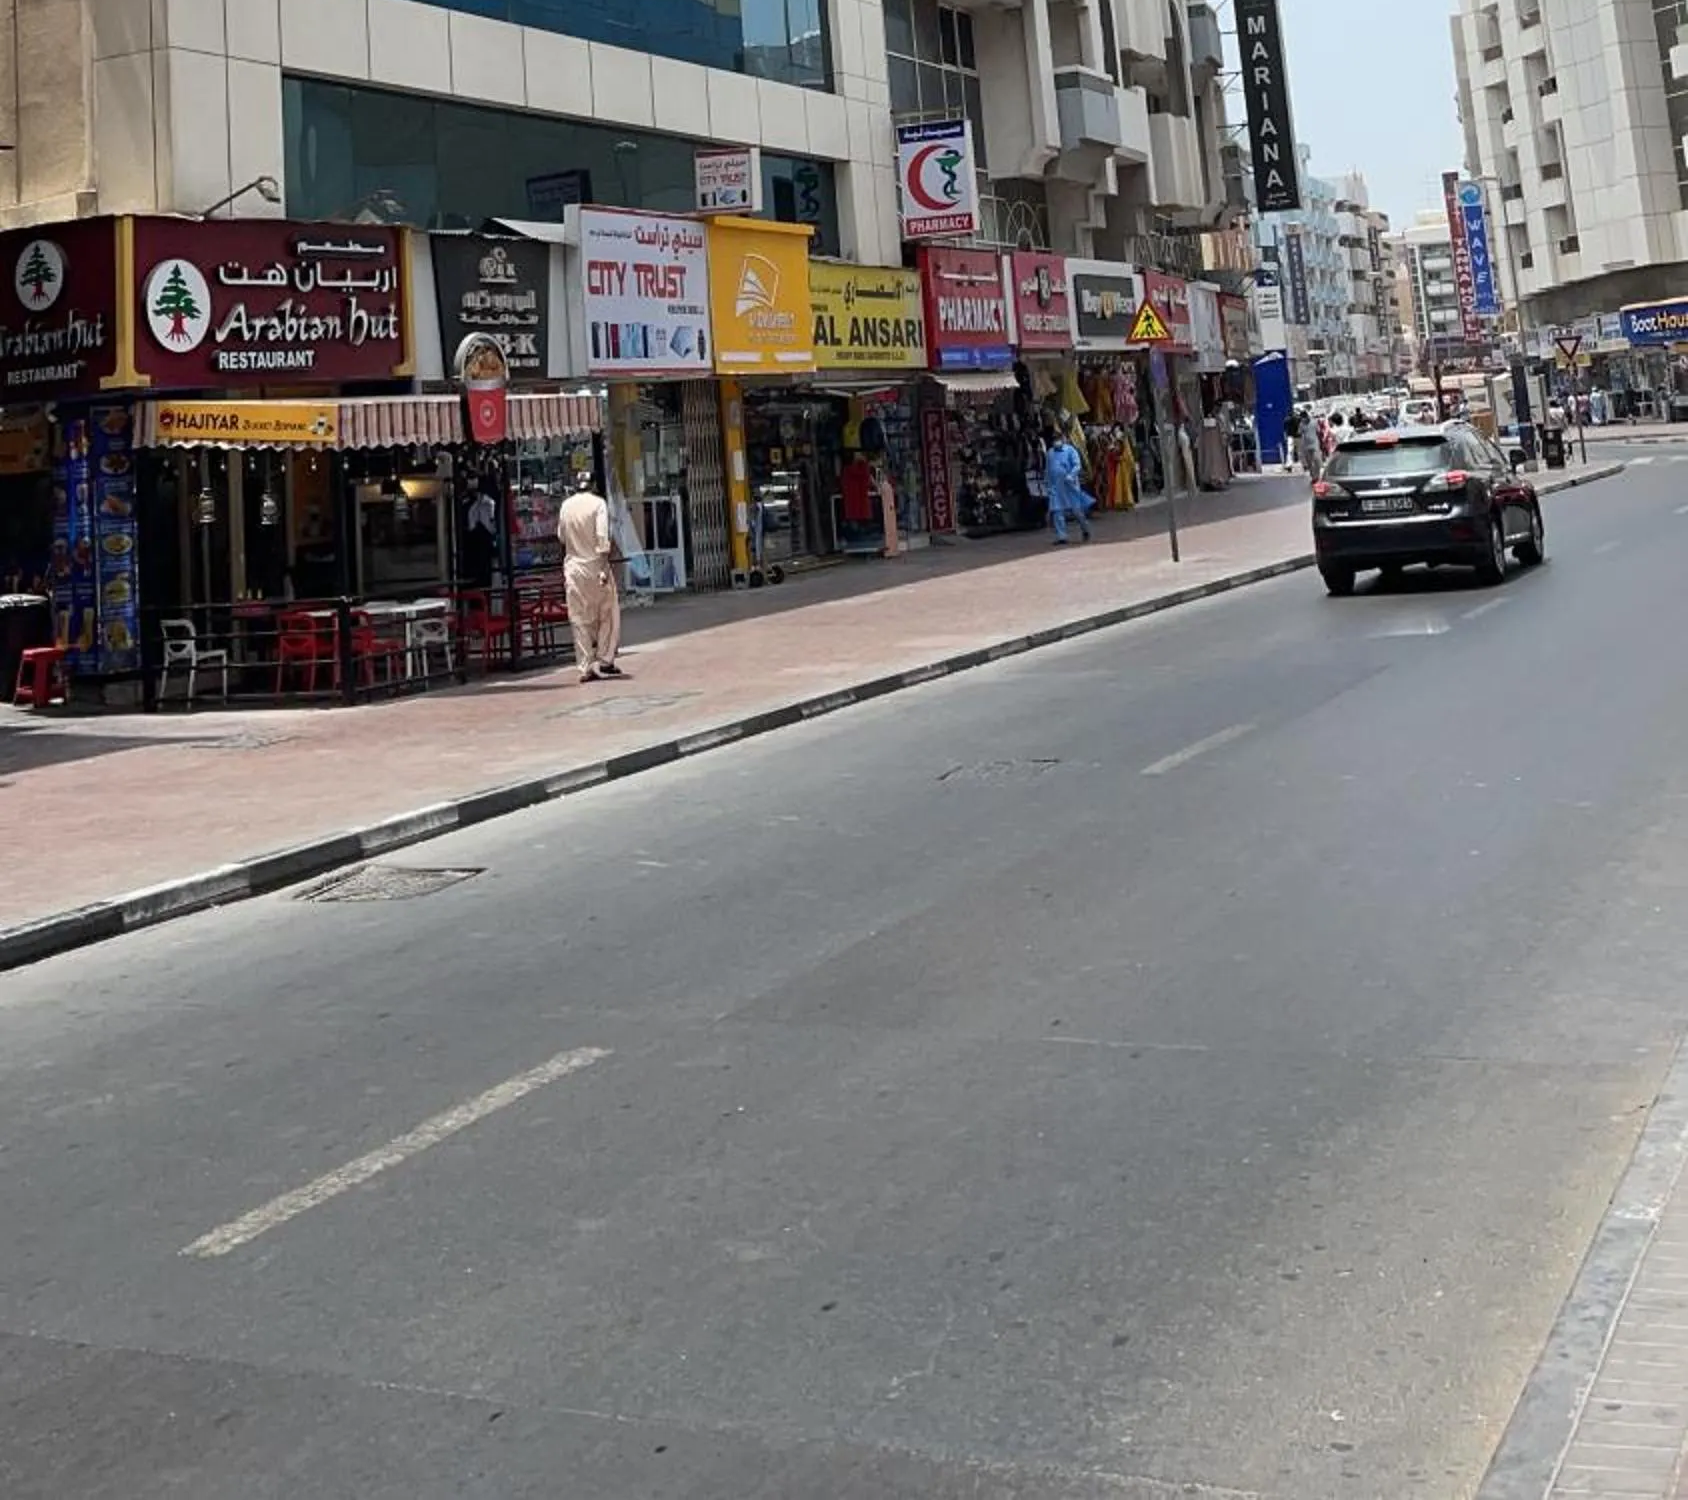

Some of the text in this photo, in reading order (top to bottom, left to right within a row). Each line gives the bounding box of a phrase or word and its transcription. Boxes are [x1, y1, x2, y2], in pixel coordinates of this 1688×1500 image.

[1246, 14, 1285, 189] MARIANA
[909, 214, 971, 234] PHARMACY
[297, 240, 385, 254] مطعم
[1467, 220, 1489, 284] WAVE
[218, 260, 397, 292] اربيان هت
[587, 260, 687, 300] CITY TRUST
[214, 298, 344, 343] Arabian
[938, 297, 1008, 332] PHARMACY
[812, 315, 842, 346] AL
[848, 317, 924, 348] ANSARI
[7, 363, 80, 387] RESTAURANT
[218, 350, 315, 369] RESTAURANT
[176, 411, 240, 431] HAJIYAR
[927, 413, 947, 527] PHARMACY
